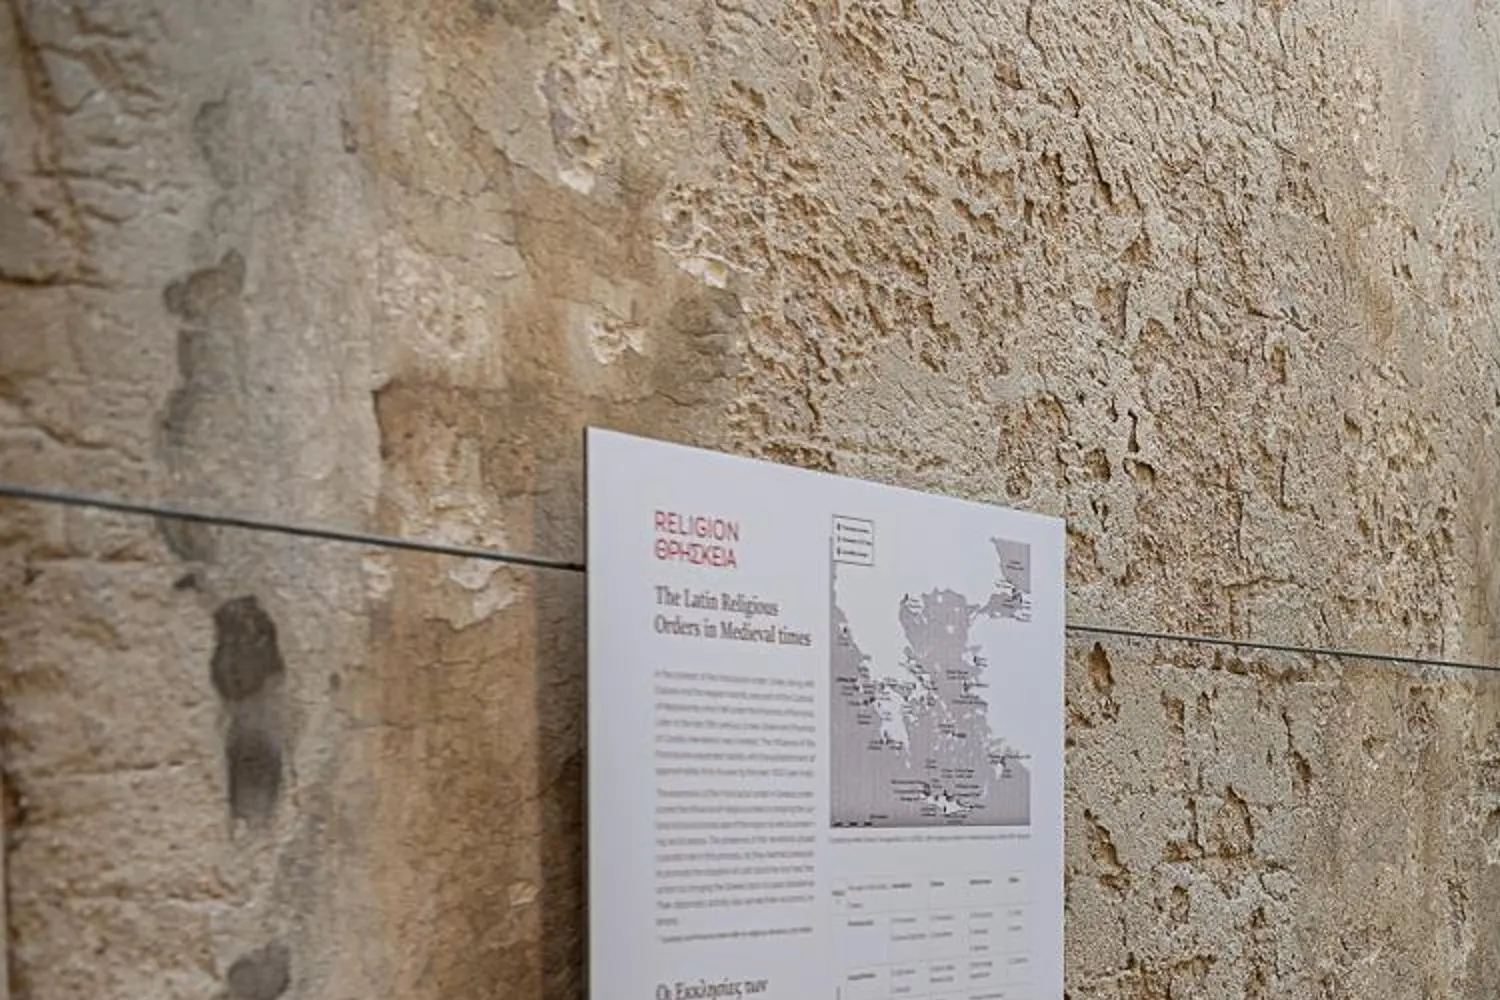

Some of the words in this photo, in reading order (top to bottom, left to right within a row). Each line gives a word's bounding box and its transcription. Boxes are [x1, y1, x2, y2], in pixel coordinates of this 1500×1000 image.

[655, 510, 740, 542] RELIGION
[655, 585, 682, 607] The
[684, 588, 719, 610] Latin
[721, 592, 780, 618] Religious
[654, 614, 701, 637] Orders
[704, 618, 718, 639] in
[720, 621, 776, 644] Medieval
[778, 625, 813, 647] times
